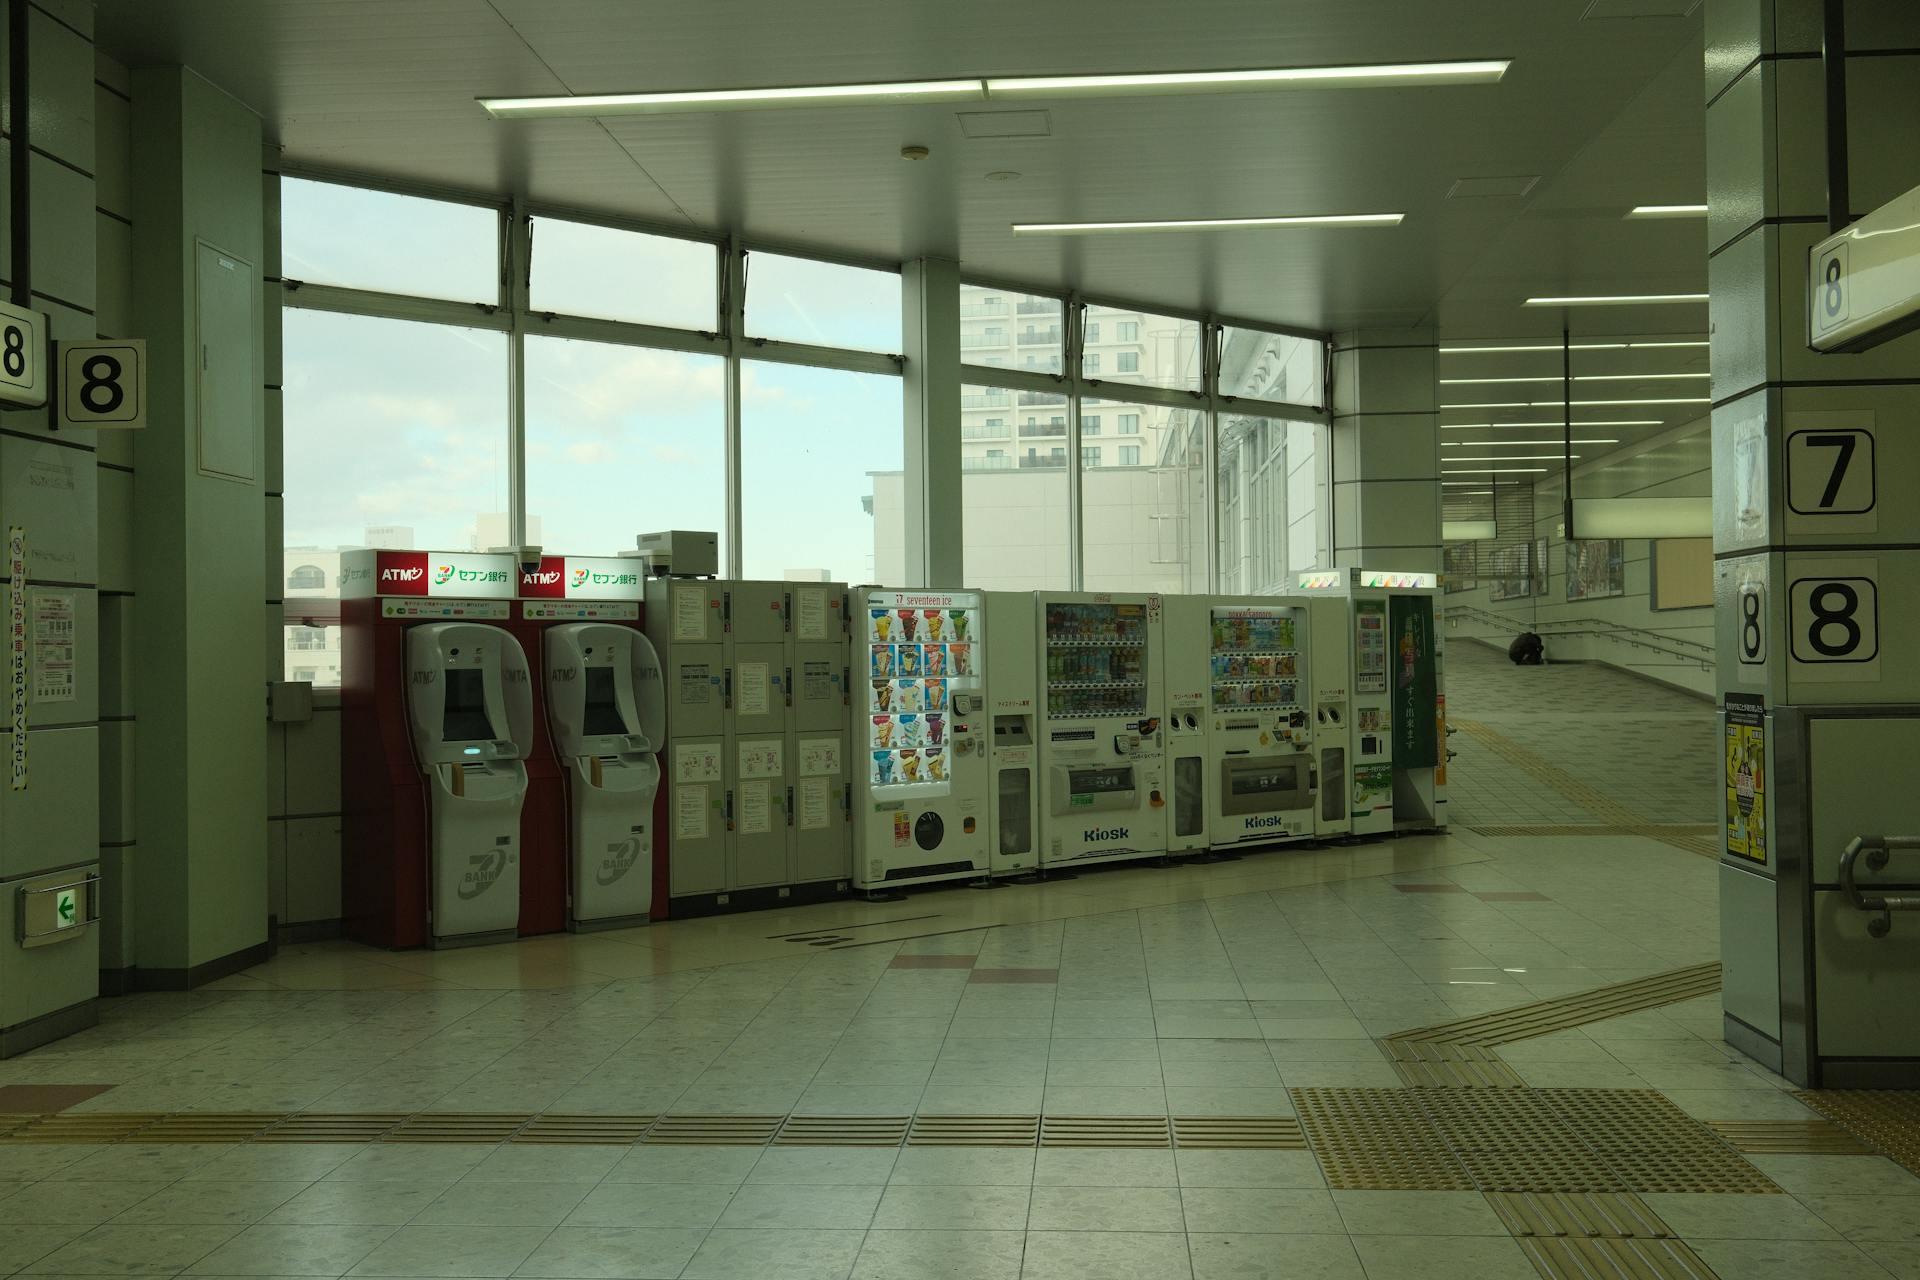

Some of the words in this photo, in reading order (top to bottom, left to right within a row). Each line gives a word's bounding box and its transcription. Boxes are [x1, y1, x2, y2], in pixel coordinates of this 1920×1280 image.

[1824, 257, 1843, 317] 8
[3, 325, 26, 378] 8
[80, 354, 124, 414] 8
[1806, 435, 1856, 508] 7
[382, 568, 412, 581] ATM
[459, 569, 508, 582] セブン銀行
[523, 573, 551, 584] ATM
[593, 573, 637, 585] セブン銀行
[907, 596, 940, 606] seventeen
[942, 595, 952, 606] ice
[1743, 593, 1761, 658] 8
[1809, 583, 1861, 657] 8
[13, 560, 24, 777] 駆け込み乗車はおやめください
[1245, 815, 1282, 829] Kiosk
[1084, 827, 1129, 842] Kiosk
[602, 858, 632, 870] BANK
[465, 870, 497, 883] BANK
